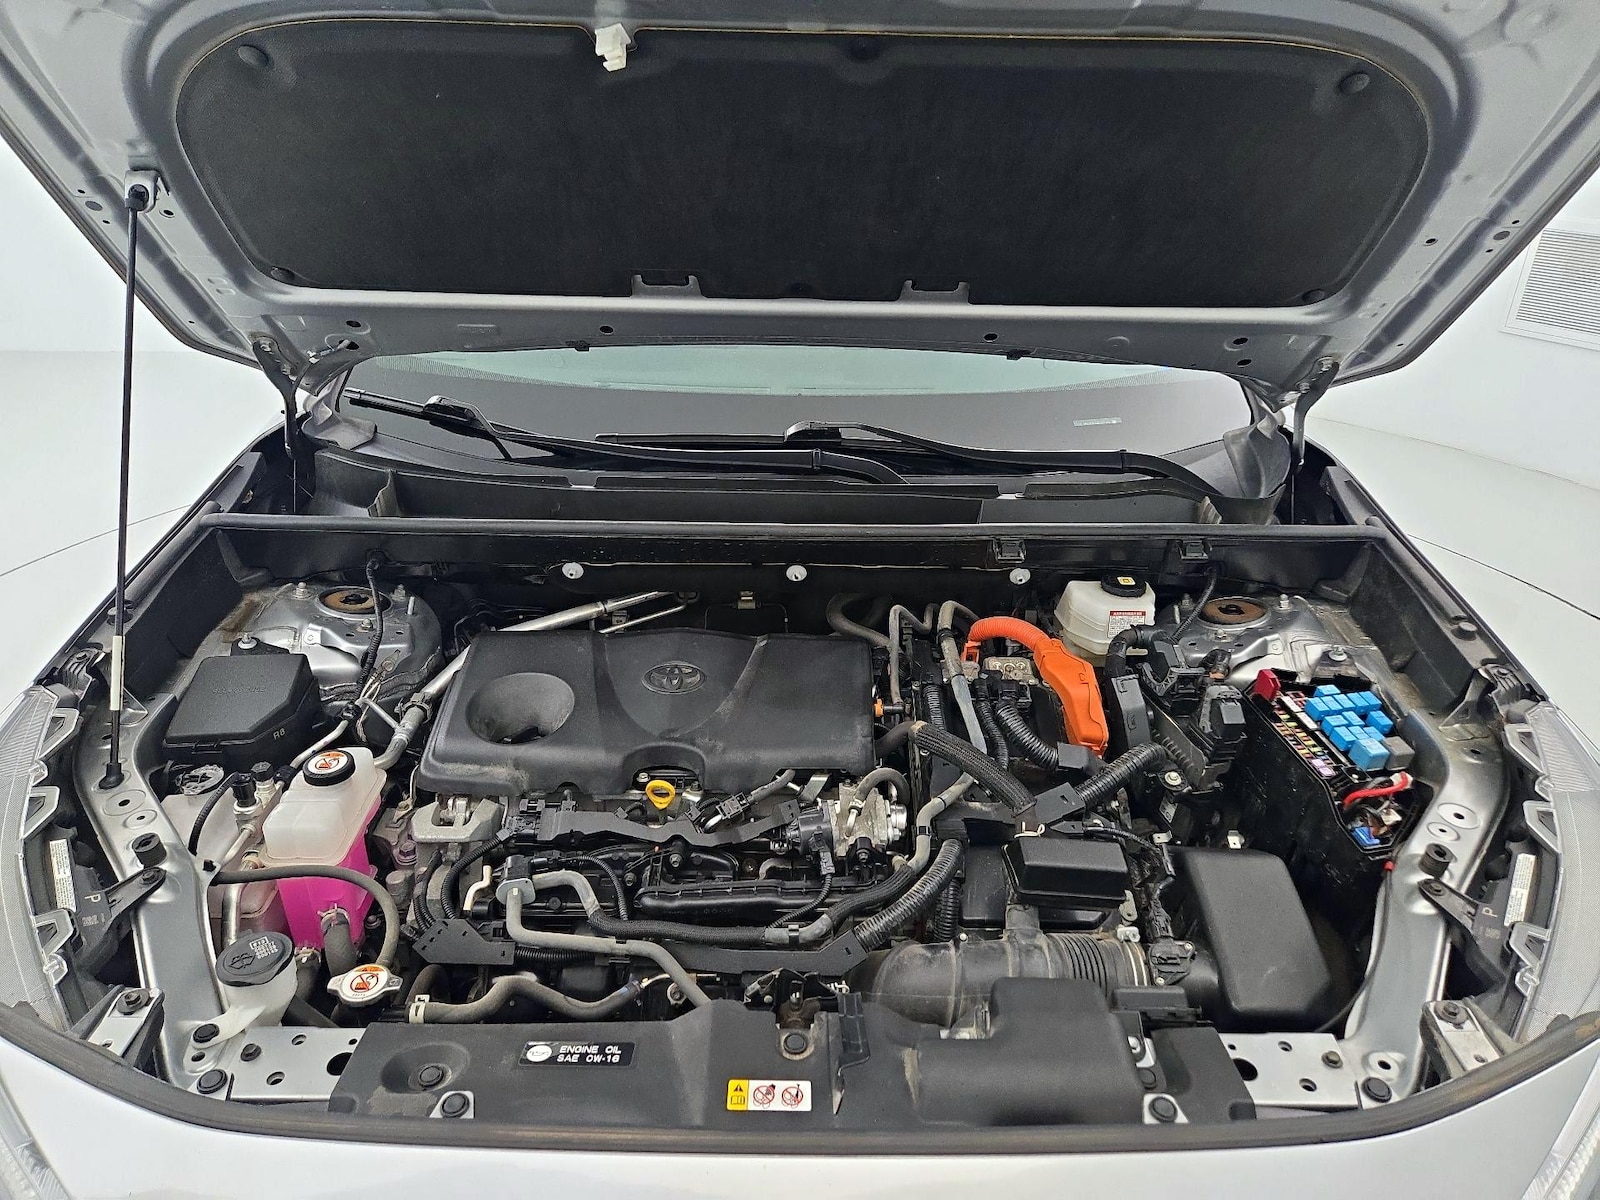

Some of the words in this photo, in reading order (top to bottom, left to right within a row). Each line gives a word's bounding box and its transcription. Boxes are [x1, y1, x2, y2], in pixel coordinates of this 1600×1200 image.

[559, 1045, 600, 1054] ENGINE
[605, 1045, 622, 1054] OIL
[557, 1054, 579, 1063] SAE
[585, 1054, 620, 1063] 0W-16
